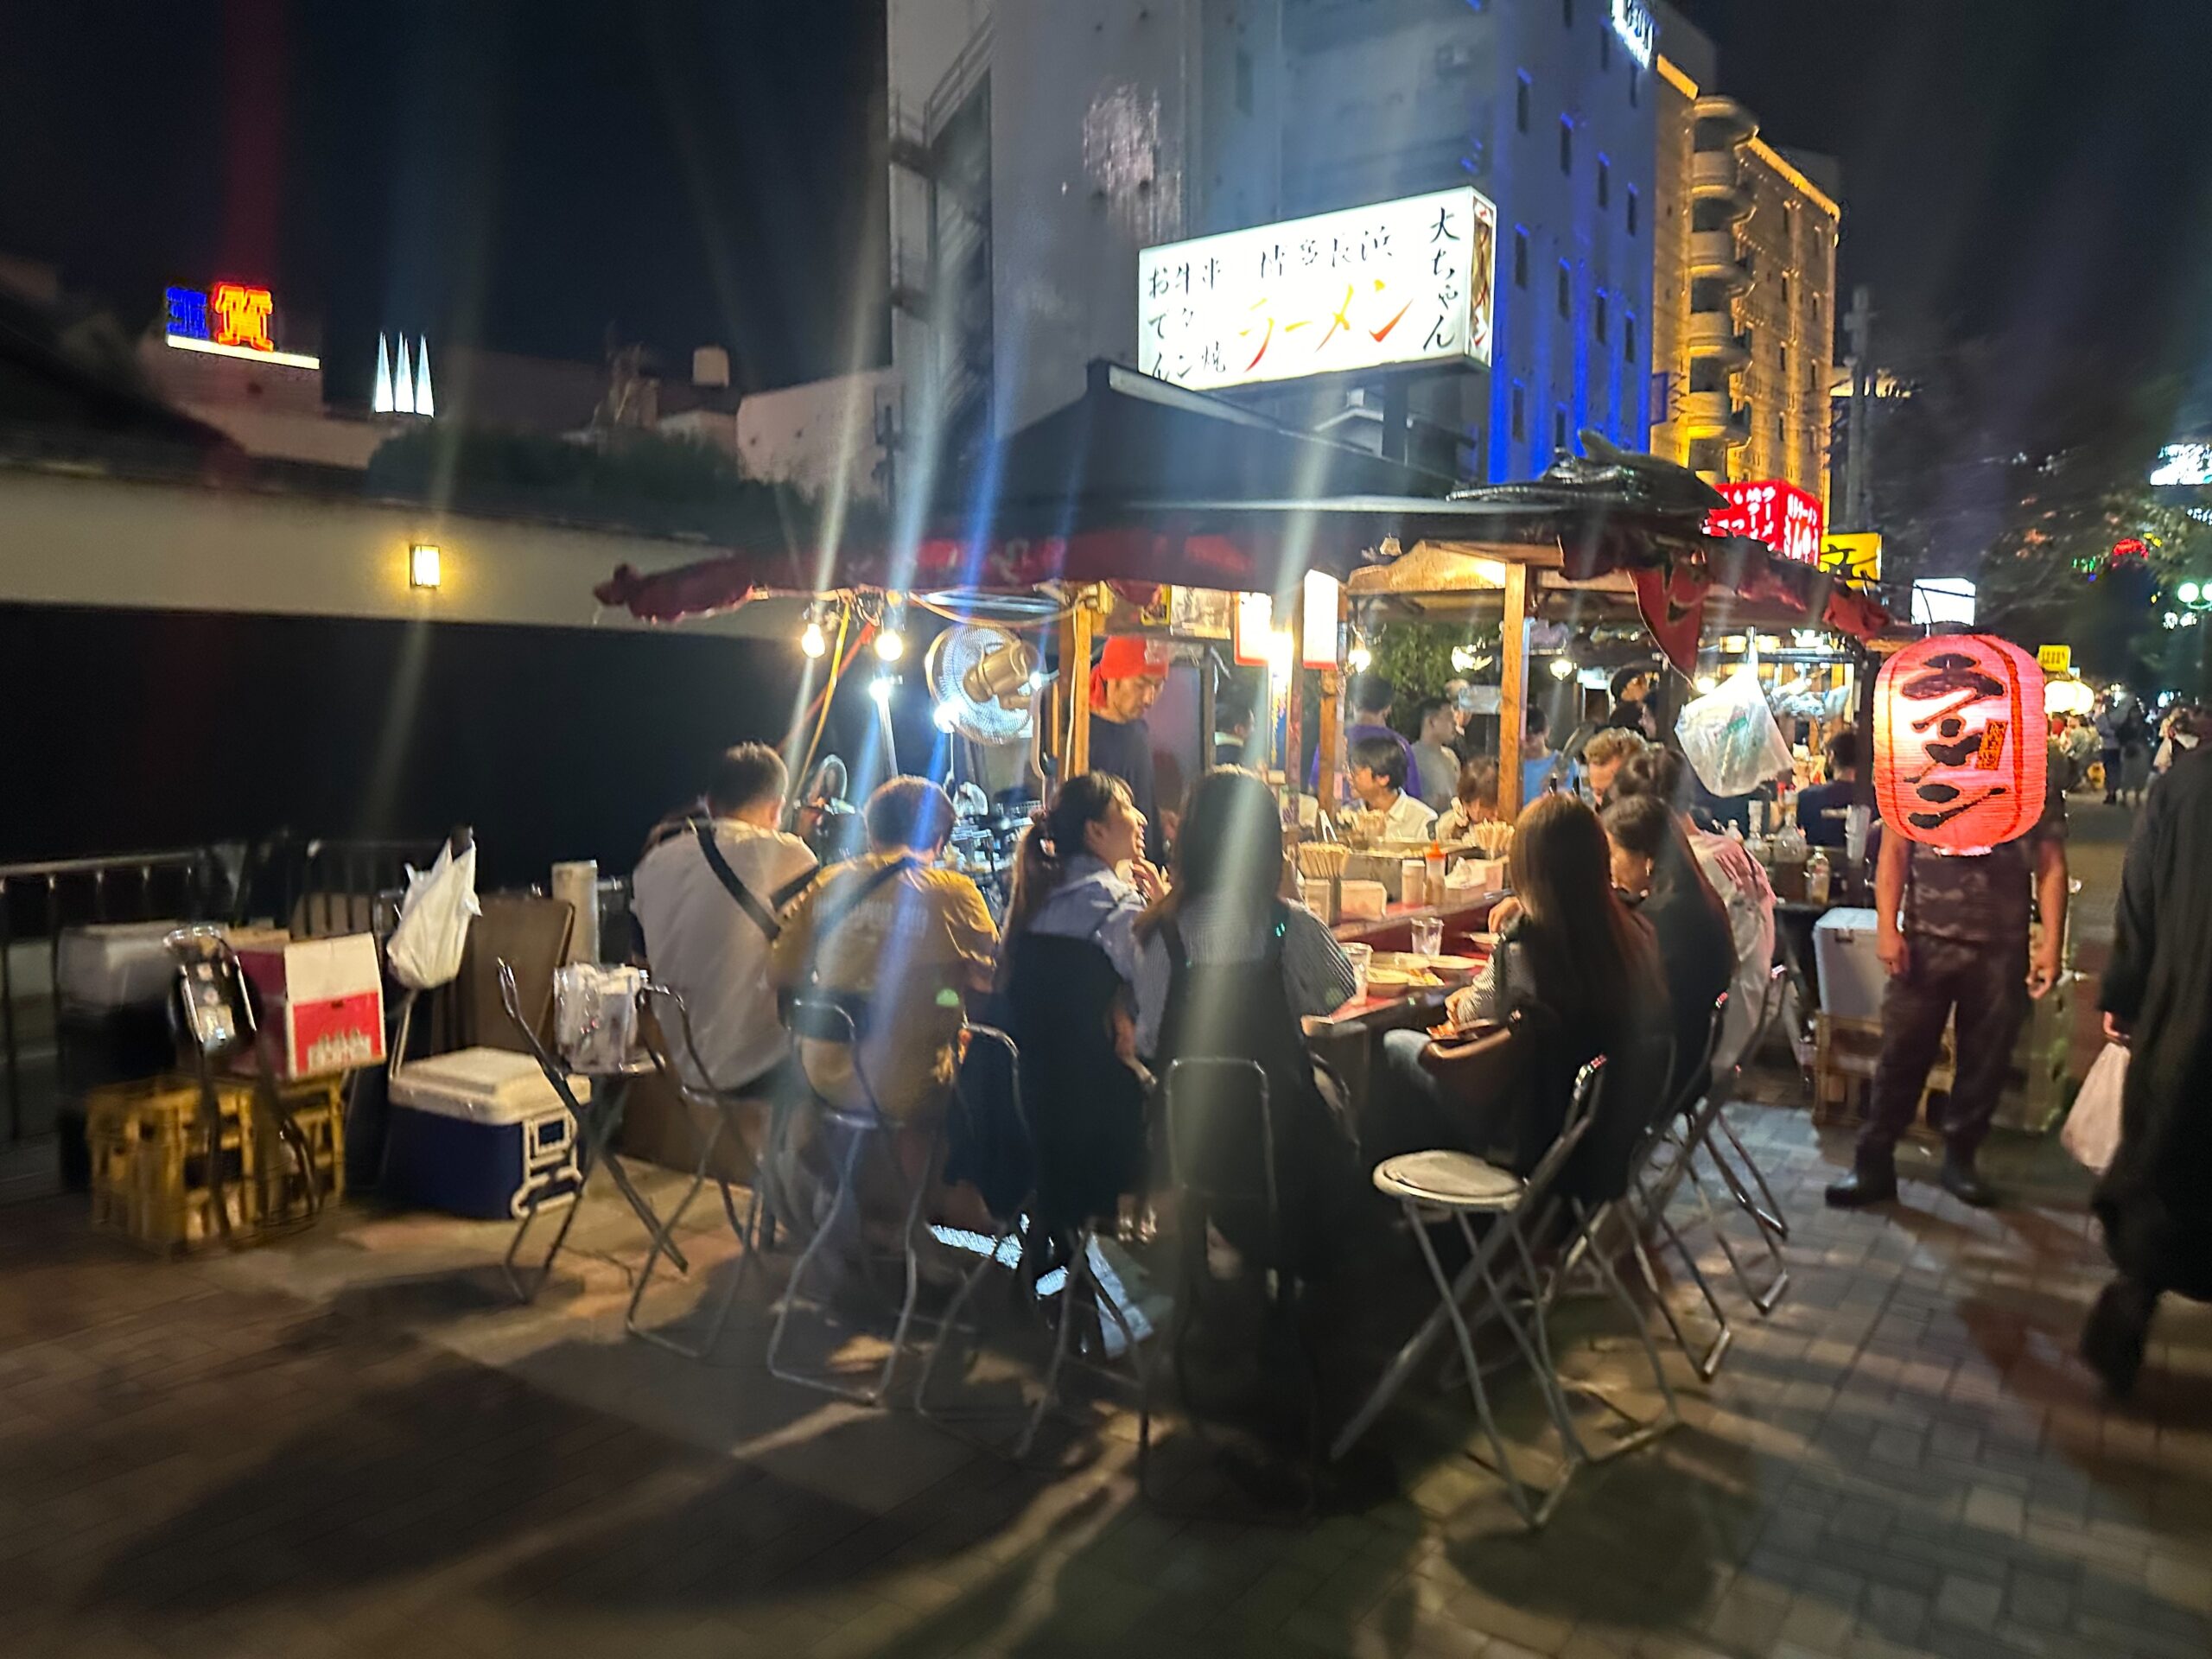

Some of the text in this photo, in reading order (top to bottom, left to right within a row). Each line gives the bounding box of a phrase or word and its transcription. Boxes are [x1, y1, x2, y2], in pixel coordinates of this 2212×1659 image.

[1237, 280, 1414, 374] ラーメン
[1423, 207, 1460, 352] 大ちゃん
